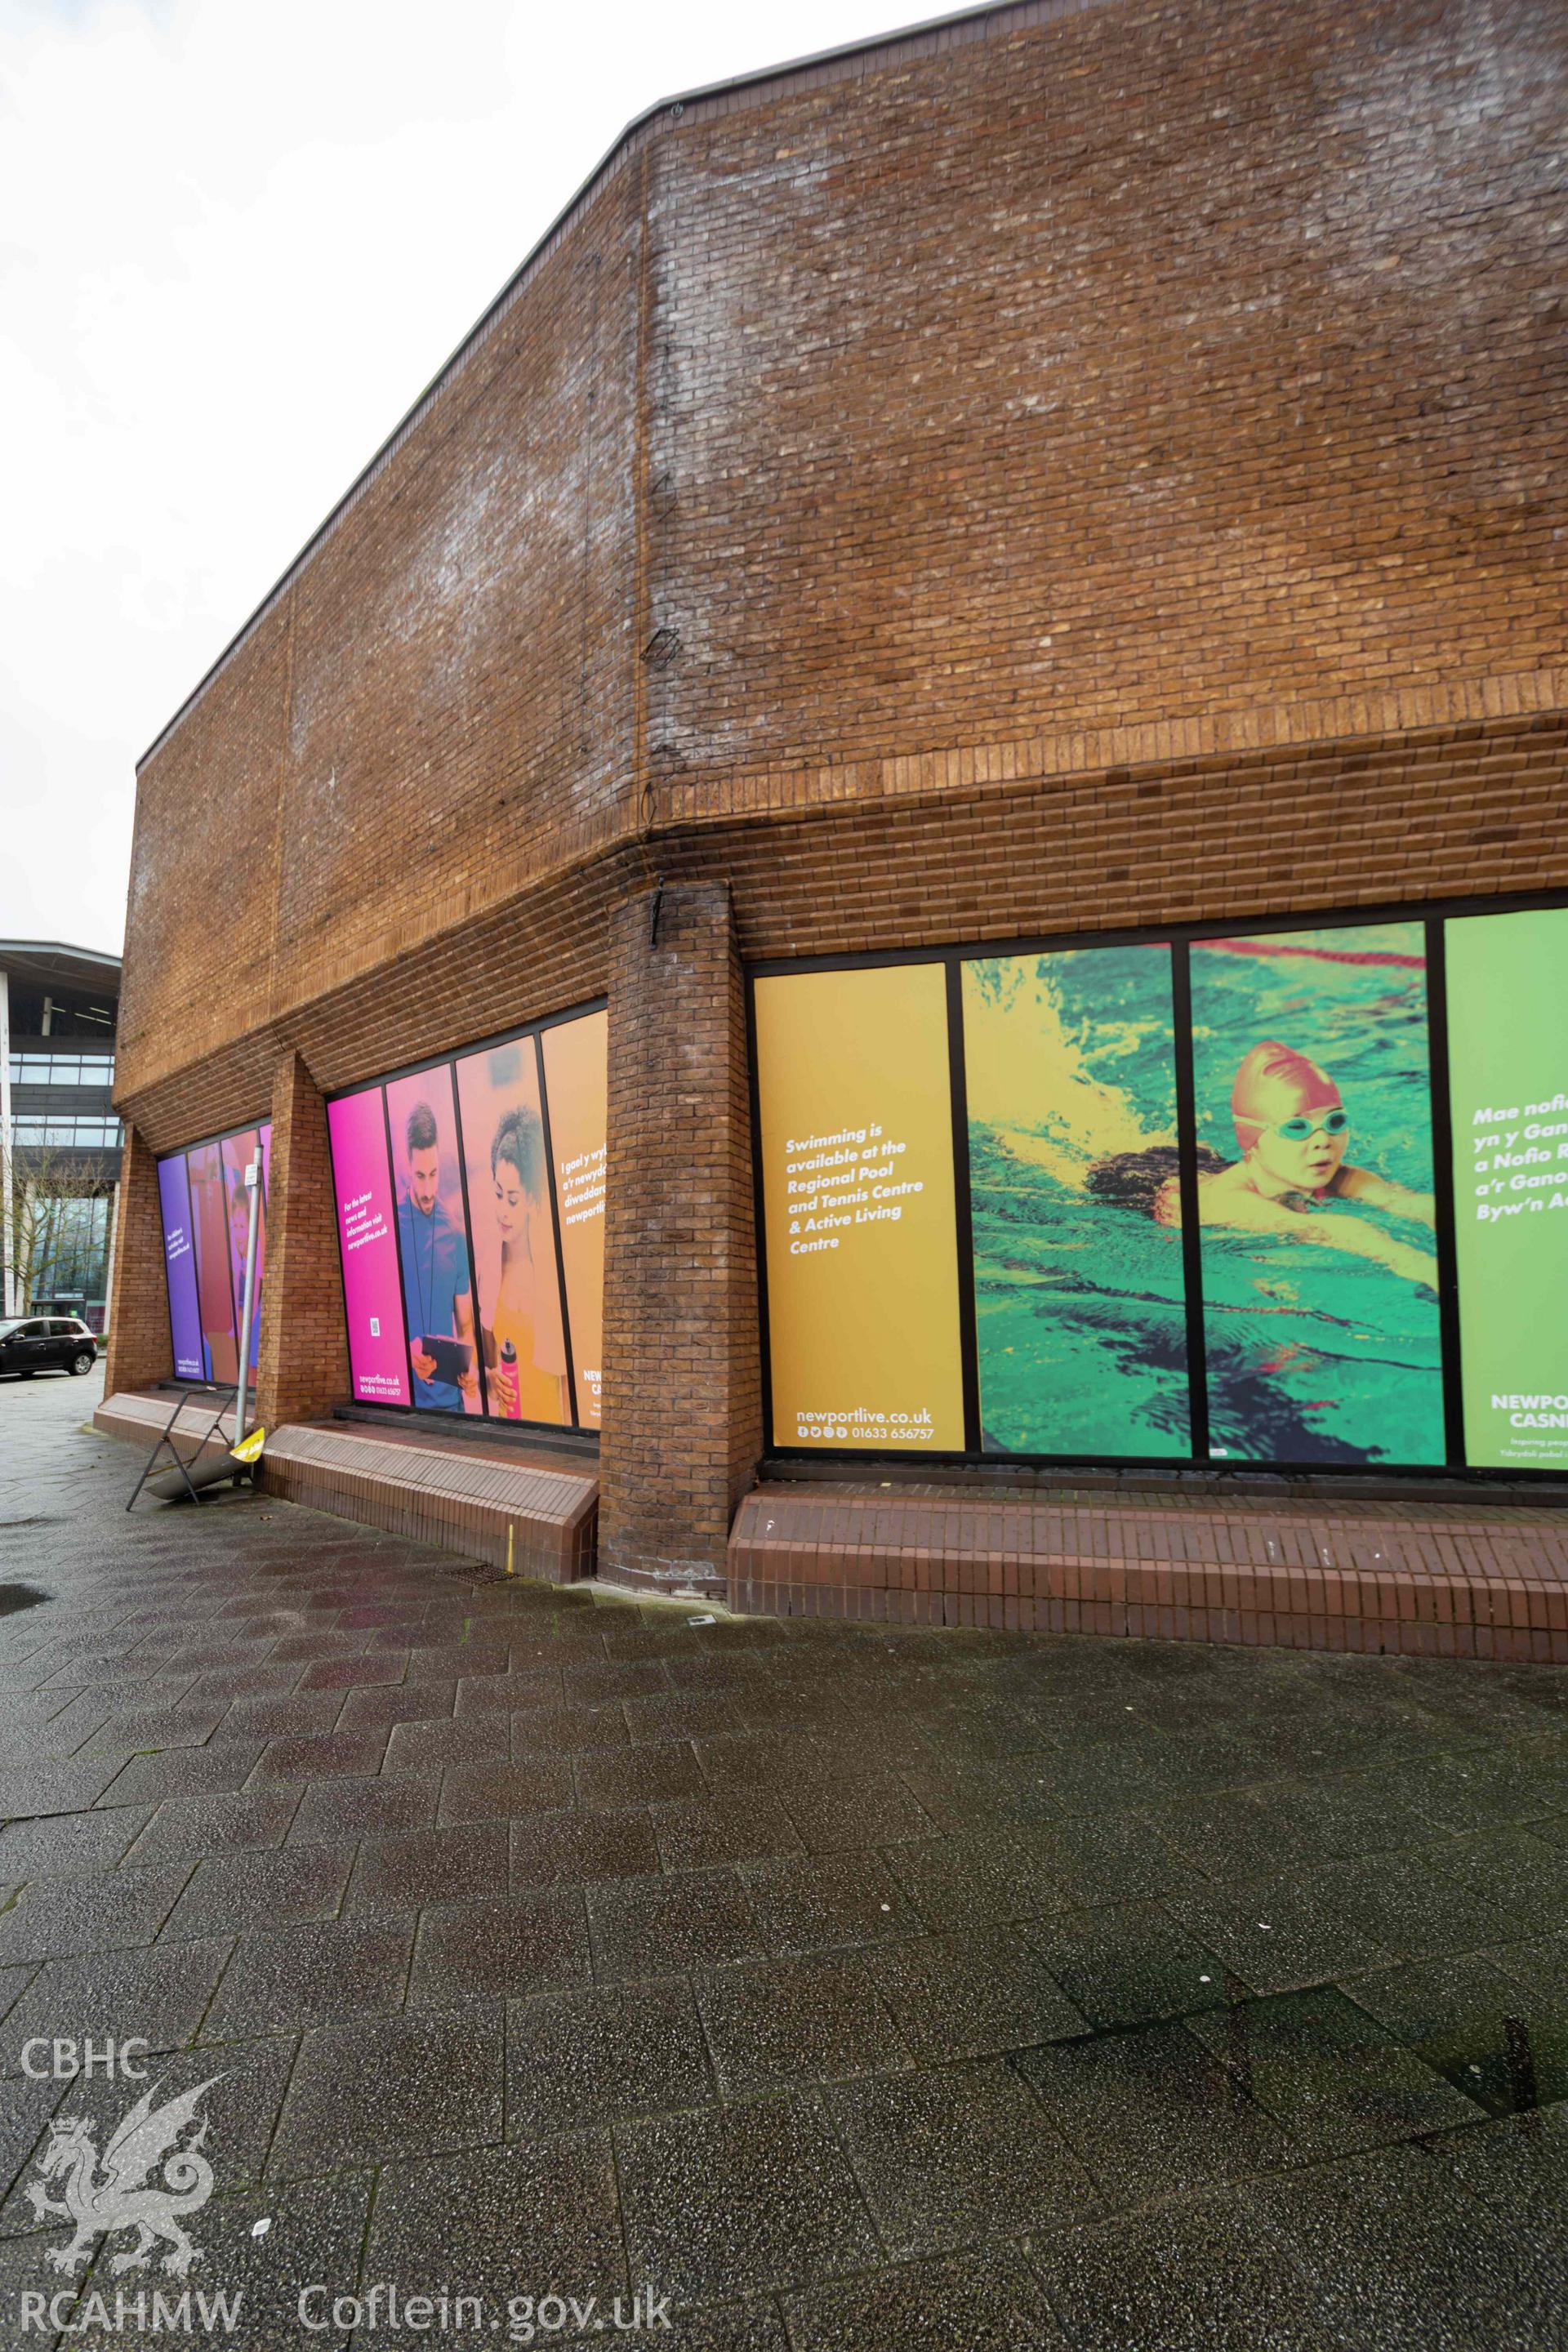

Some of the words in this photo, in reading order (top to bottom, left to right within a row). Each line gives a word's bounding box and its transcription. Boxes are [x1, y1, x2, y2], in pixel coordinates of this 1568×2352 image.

[1472, 1107, 1519, 1125] Mae
[786, 1129, 866, 1153] Swimming
[870, 1123, 882, 1137] is
[1474, 1134, 1500, 1153] yn
[1504, 1131, 1519, 1148] y
[566, 1154, 582, 1174] gael
[584, 1154, 590, 1167] y
[786, 1148, 858, 1174] available
[862, 1145, 879, 1160] at
[881, 1140, 906, 1156] the
[1474, 1160, 1489, 1173] a
[1494, 1147, 1552, 1169] Nofio
[787, 1169, 855, 1194] Regional
[858, 1161, 894, 1181] Pool
[1475, 1178, 1505, 1196] a'r
[788, 1196, 817, 1214] and
[821, 1188, 869, 1209] Tennis
[872, 1181, 924, 1200] Centre
[789, 1220, 801, 1235] &
[804, 1213, 851, 1232] Active
[855, 1205, 902, 1224] Living
[1476, 1197, 1544, 1223] Byw'n
[790, 1238, 840, 1254] Centre
[796, 1407, 932, 1425] newportlive.co.uk
[1509, 1413, 1568, 1428] CASN
[852, 1428, 887, 1439] 01633
[891, 1428, 934, 1440] 656757
